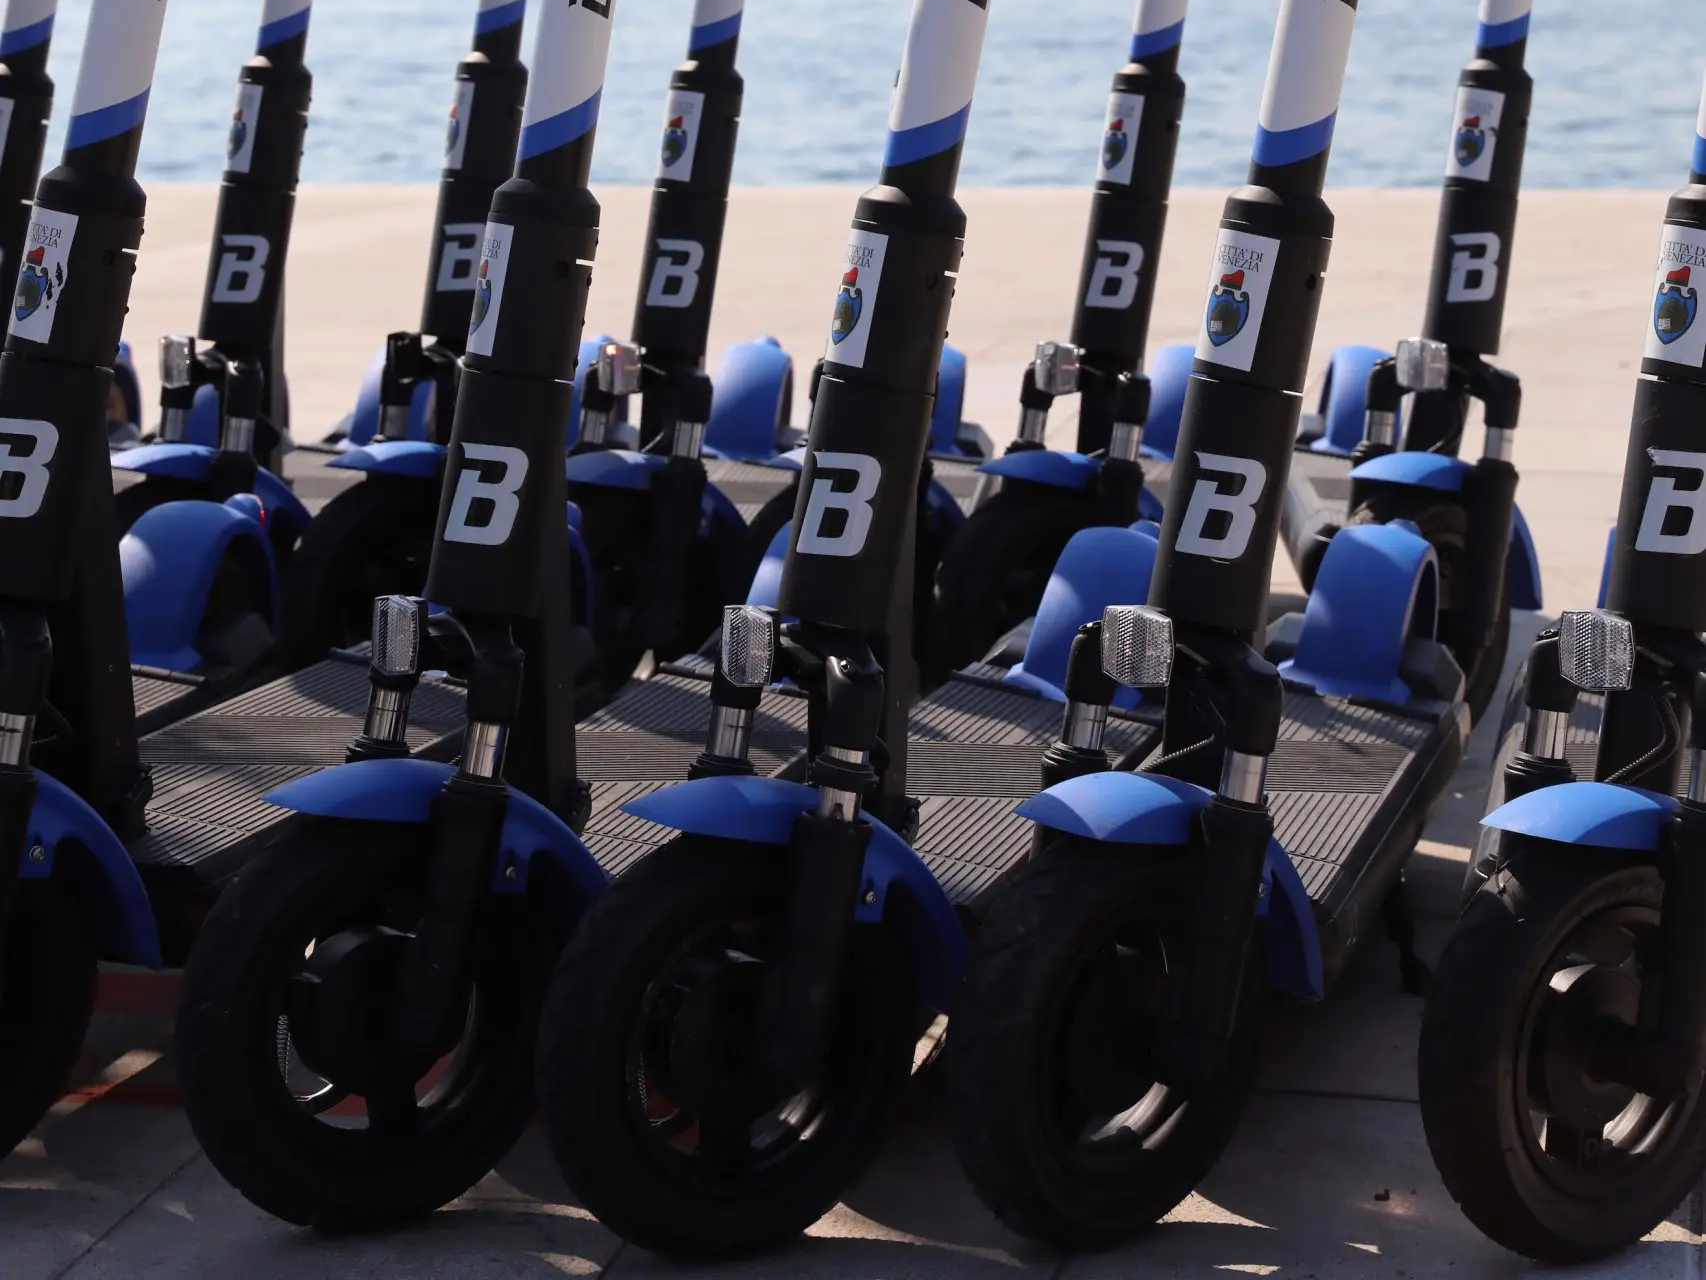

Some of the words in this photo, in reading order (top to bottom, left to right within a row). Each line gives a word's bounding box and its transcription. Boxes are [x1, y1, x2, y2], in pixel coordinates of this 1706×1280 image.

[50, 228, 62, 238] DI
[436, 223, 486, 291] B
[862, 247, 874, 258] DI
[1250, 251, 1264, 263] DI
[1447, 232, 1501, 303] B
[1694, 246, 1706, 258] D
[212, 234, 269, 303] B
[646, 239, 704, 308] B
[1084, 240, 1143, 309] B
[0, 418, 58, 518] B
[443, 442, 529, 546] B
[1635, 448, 1706, 555] B
[796, 451, 882, 557] B
[1176, 452, 1268, 561] B
